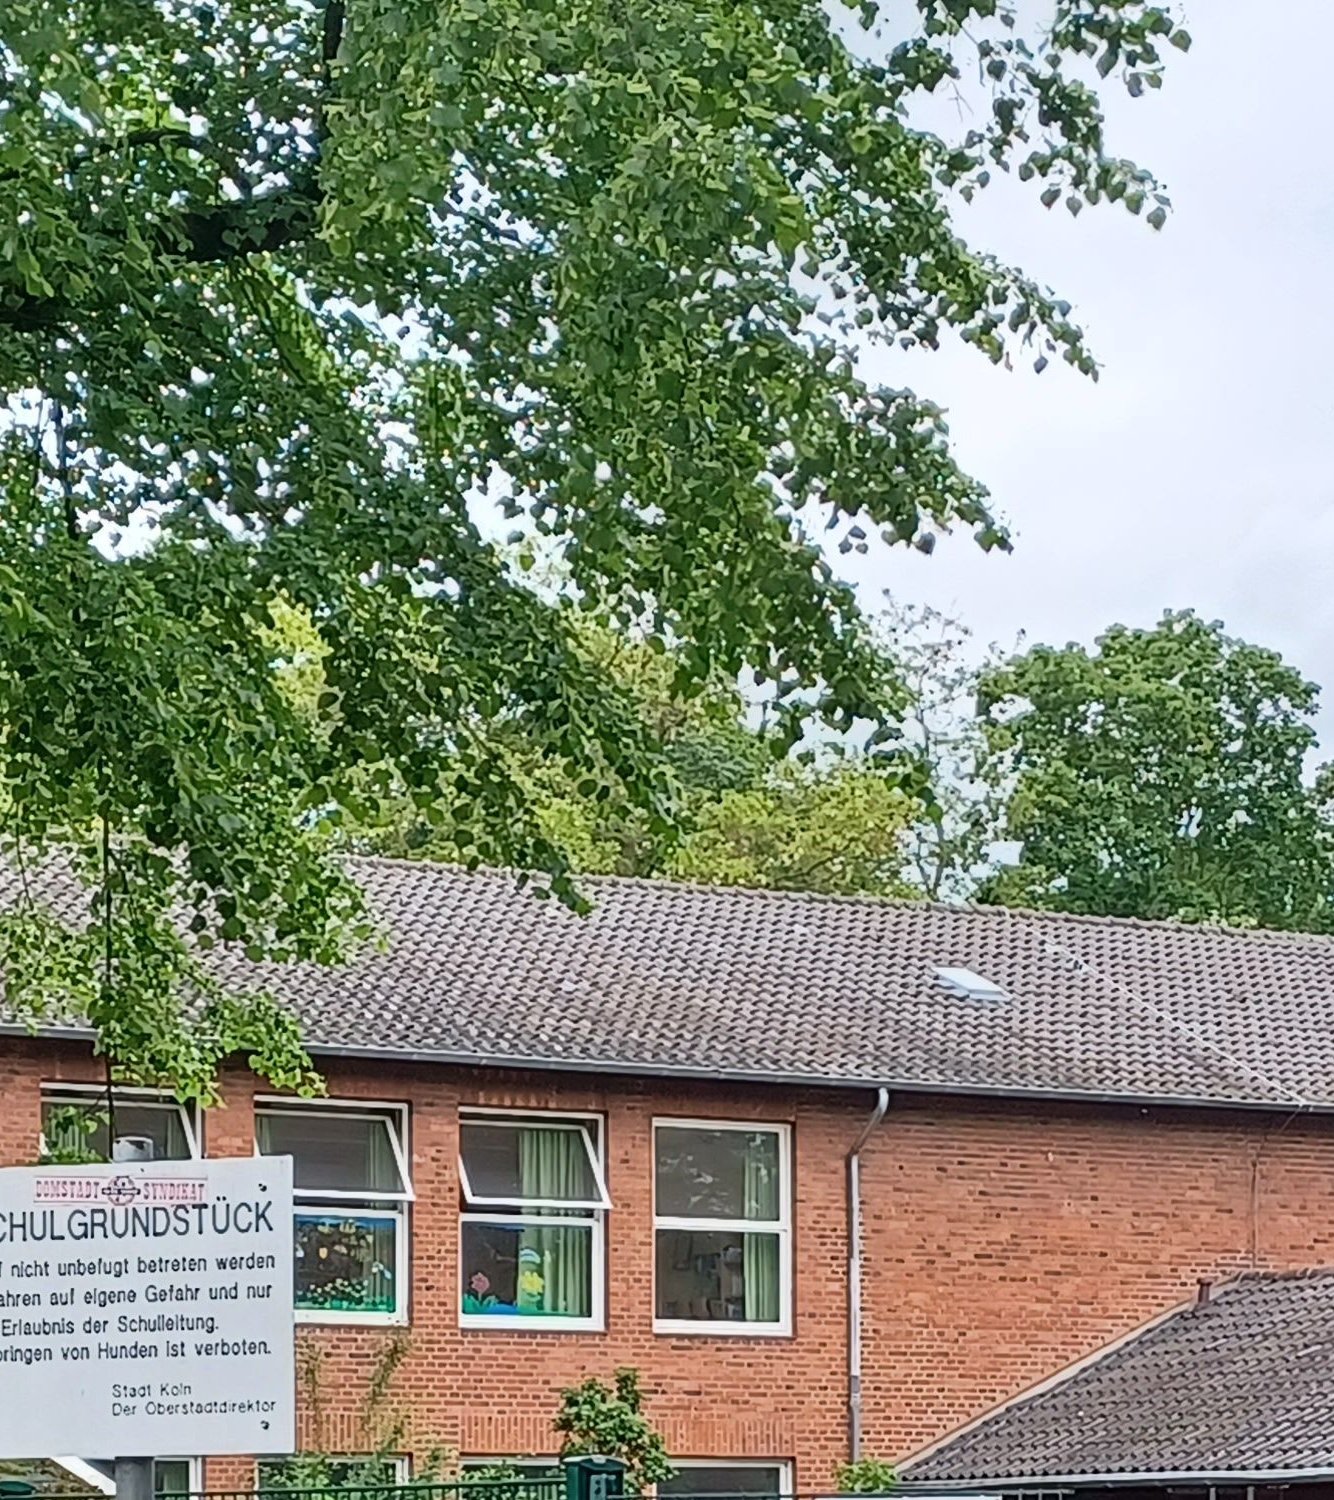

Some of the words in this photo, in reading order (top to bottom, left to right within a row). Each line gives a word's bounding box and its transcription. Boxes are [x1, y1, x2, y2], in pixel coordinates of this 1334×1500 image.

[36, 1180, 100, 1199] DOMSTADT
[143, 1182, 205, 1201] SYNDIKAT
[11, 1260, 50, 1278] nicht
[57, 1258, 129, 1279] unbefugt
[137, 1256, 207, 1274] betreten
[216, 1252, 276, 1270] werden
[50, 1288, 75, 1306] auf
[83, 1288, 137, 1308] eigene
[145, 1284, 201, 1303] Gefahr
[209, 1282, 239, 1300] und
[247, 1284, 273, 1299] nur
[1, 1317, 75, 1336] Erlaubnis
[82, 1316, 109, 1334] der
[117, 1314, 219, 1334] Schulleitung.
[60, 1346, 90, 1361] von
[97, 1341, 158, 1359] Hunden
[166, 1341, 186, 1357] ist
[194, 1338, 272, 1356] verboten.
[112, 1384, 151, 1398] Stadt
[112, 1402, 137, 1416] Der
[145, 1399, 276, 1415] Oberstadtdirektor
